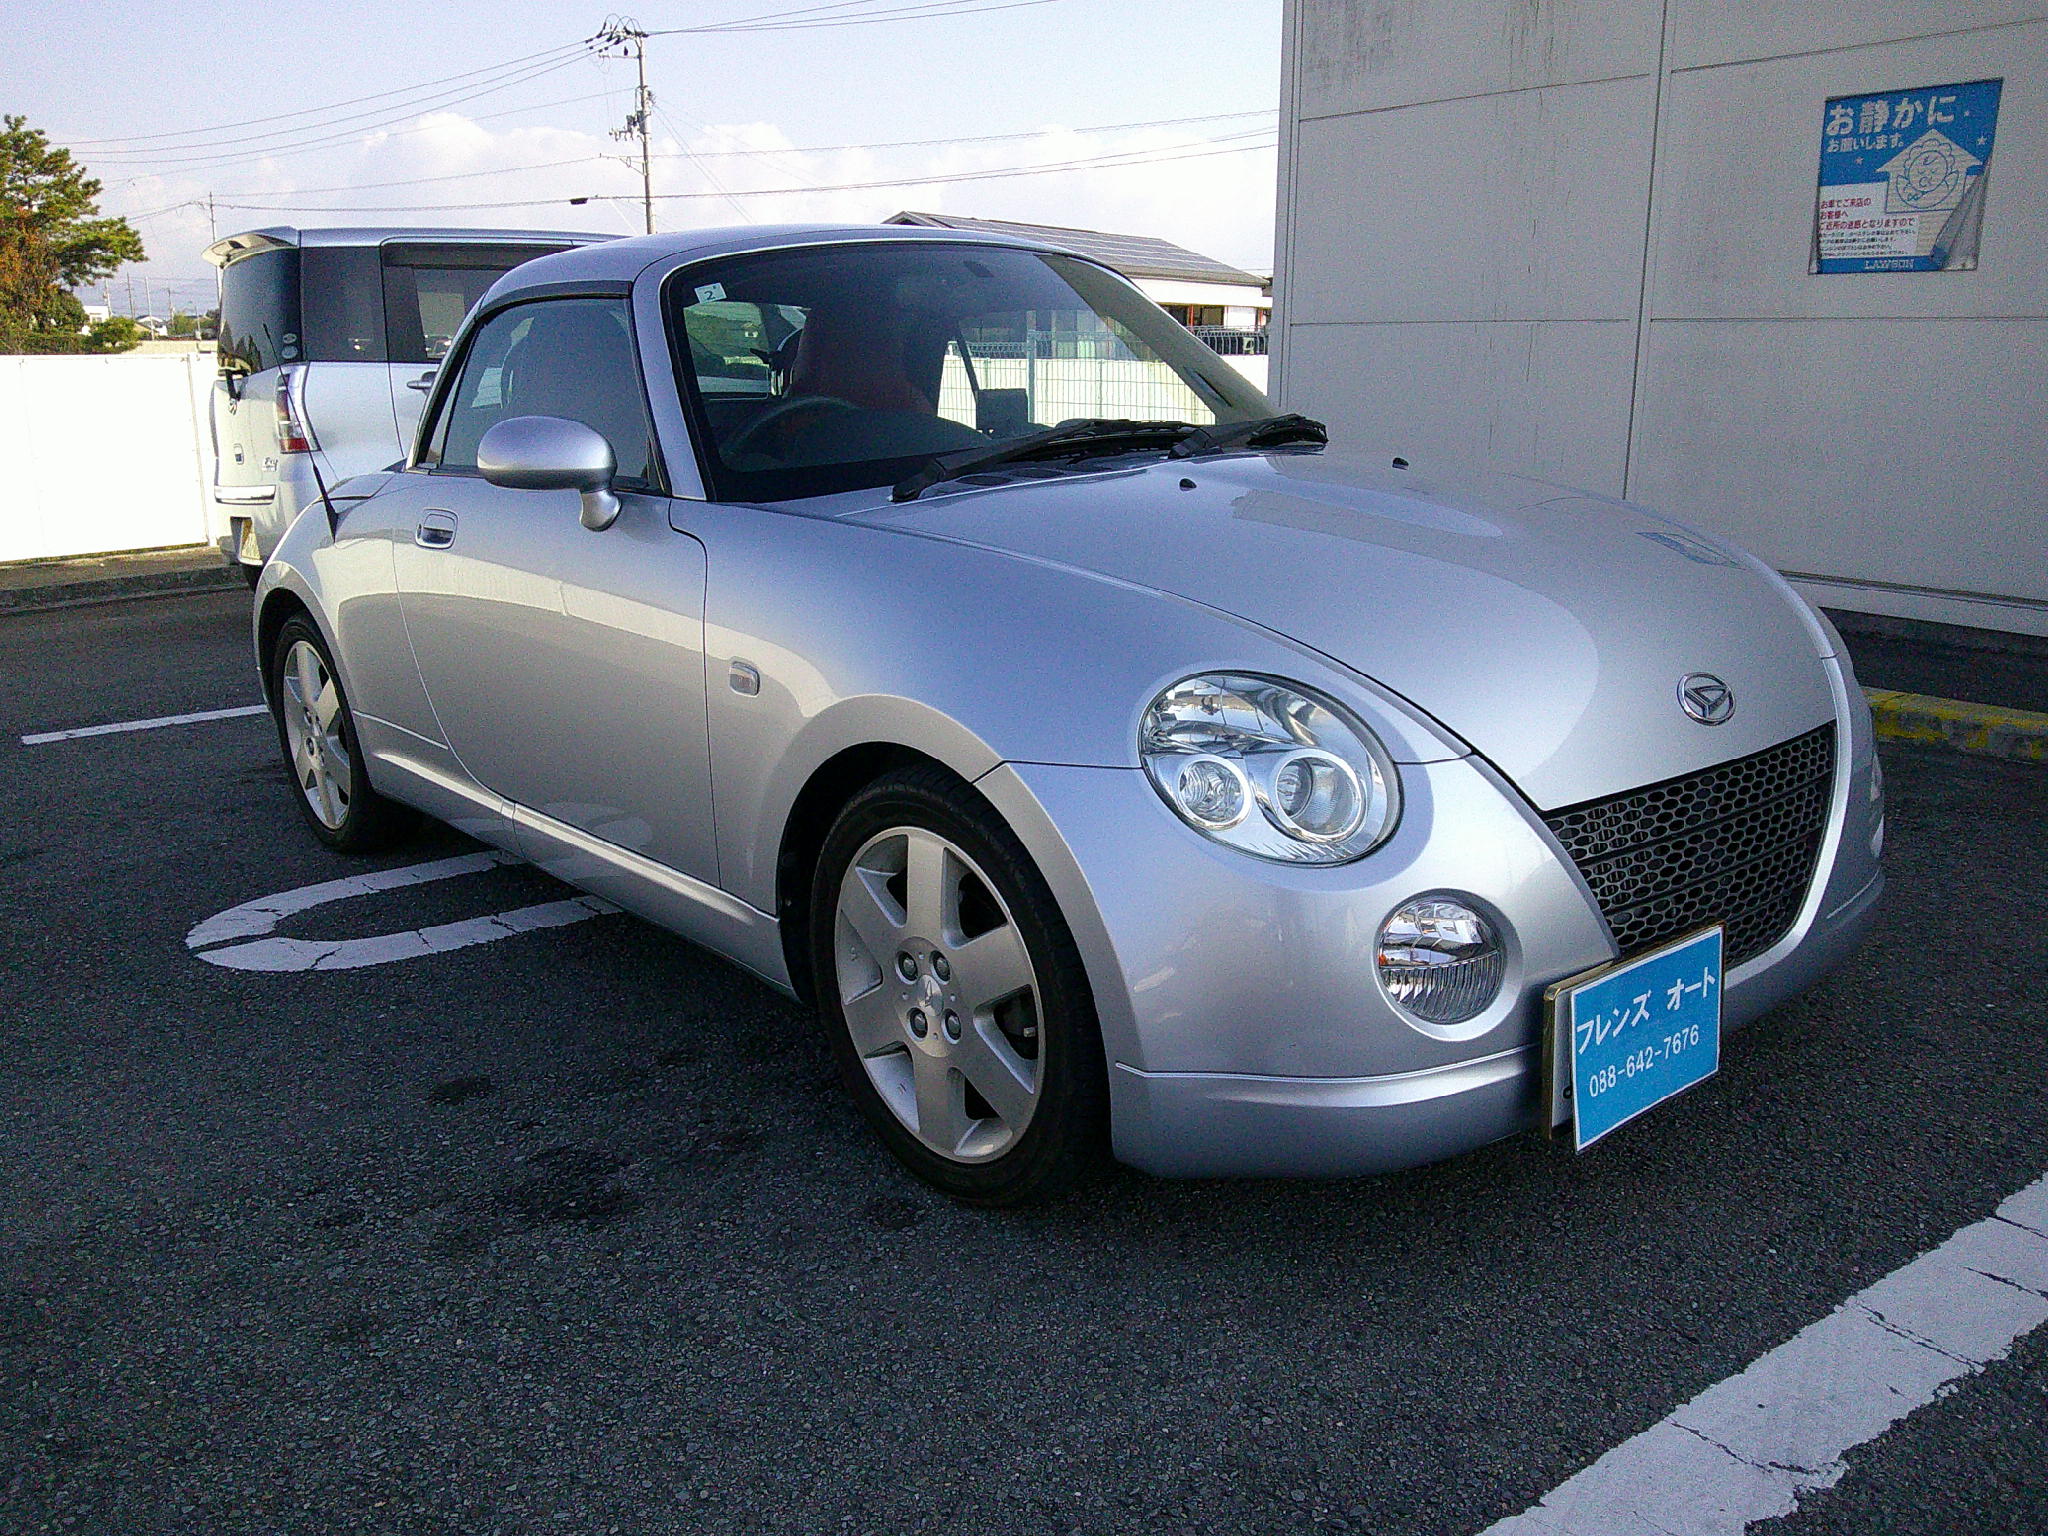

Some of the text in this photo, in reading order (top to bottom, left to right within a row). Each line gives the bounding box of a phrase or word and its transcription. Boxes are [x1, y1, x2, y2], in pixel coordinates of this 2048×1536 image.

[1826, 96, 1956, 136] お静かに
[1827, 132, 1904, 152] お願いします。
[704, 290, 716, 300] 2
[1576, 966, 1716, 1055] フレンズ オート
[1588, 1024, 1699, 1097] 088-642-7676
